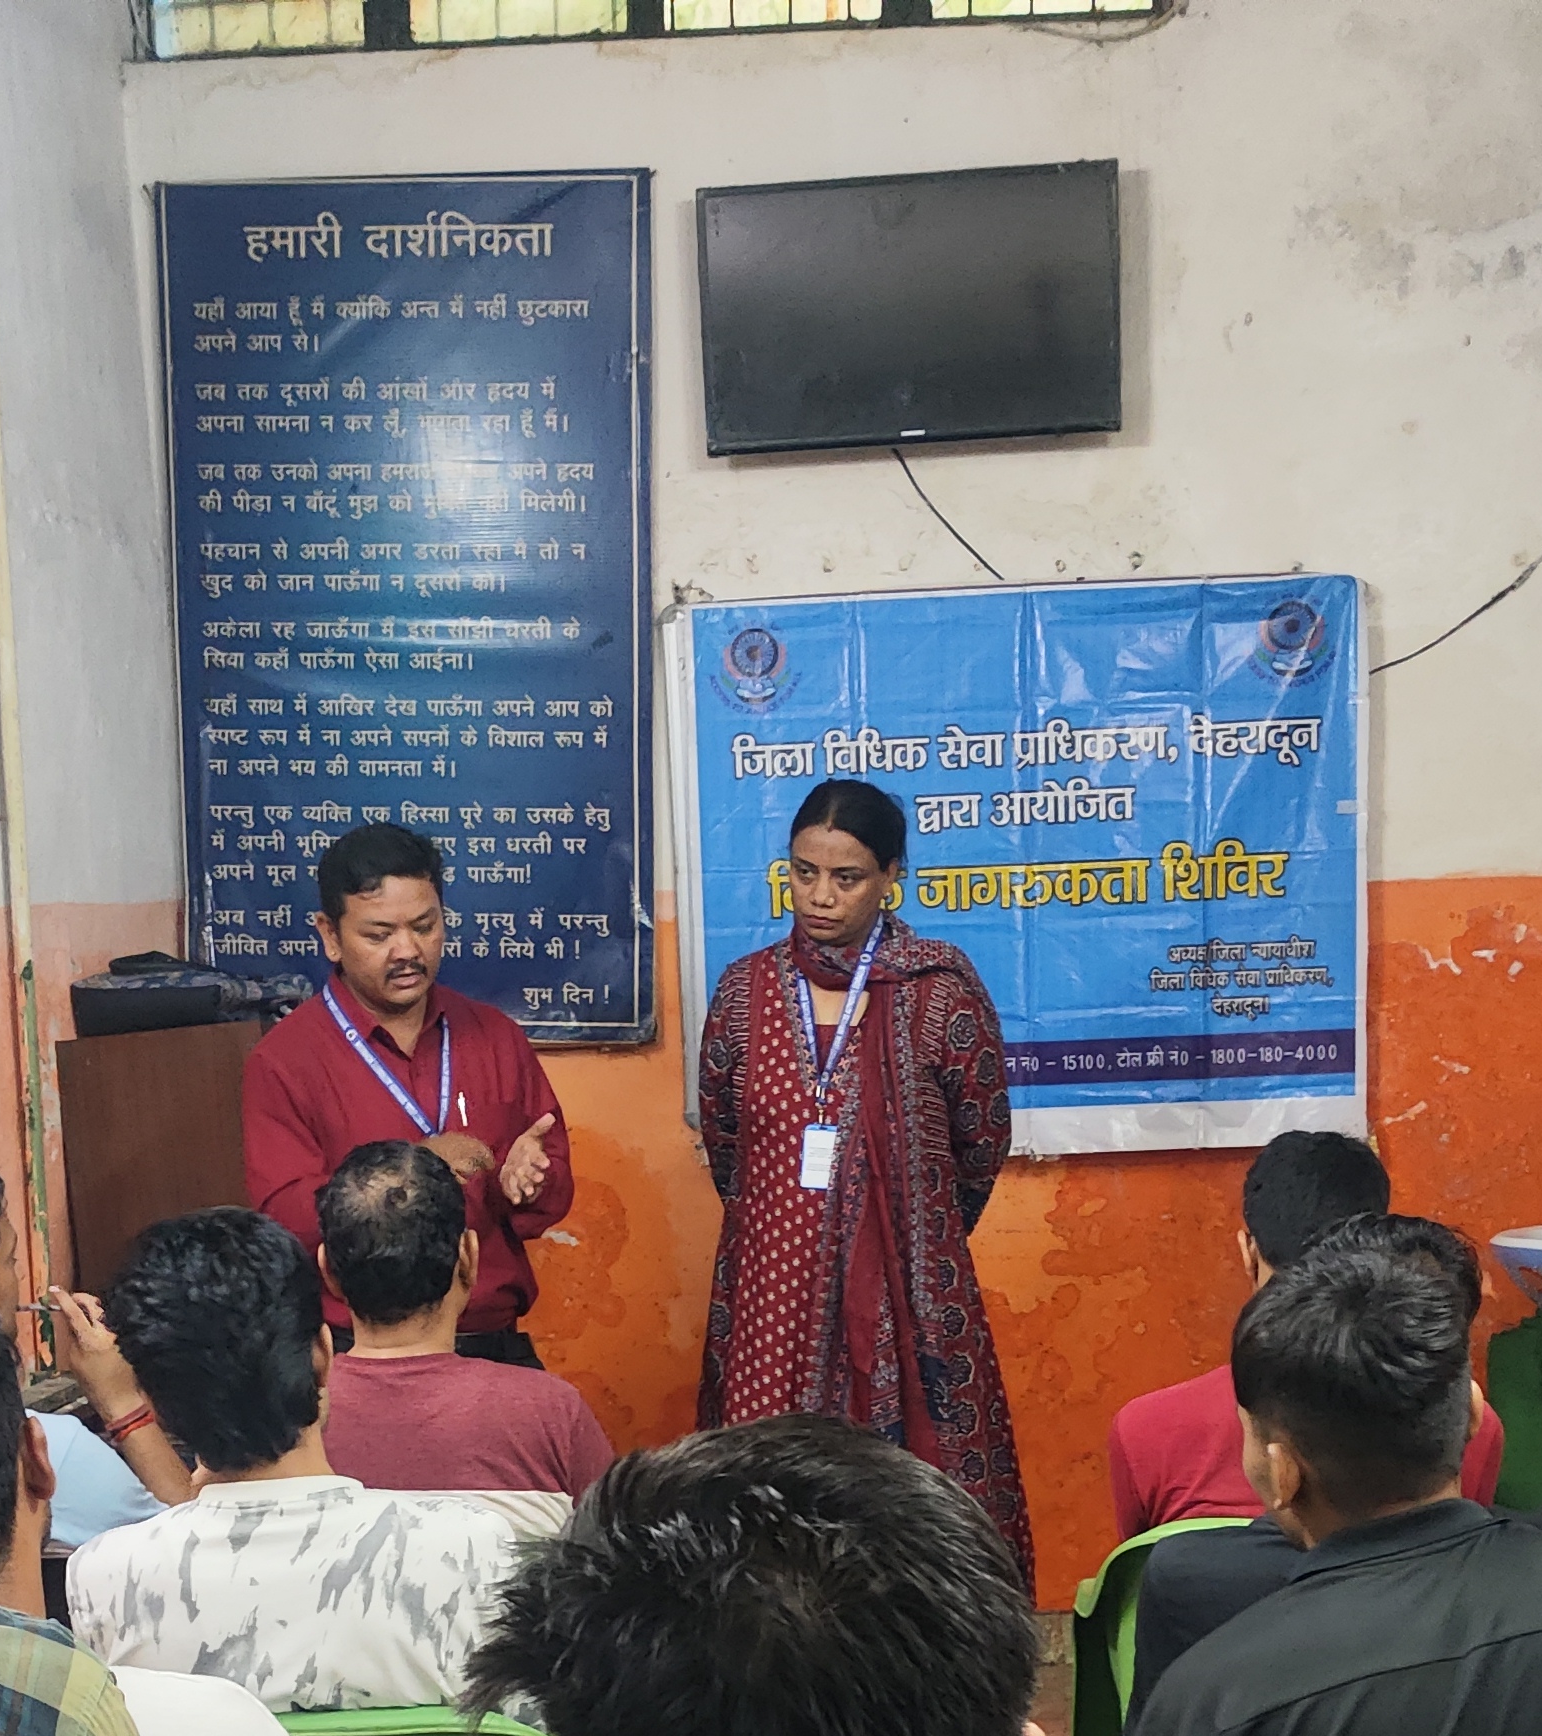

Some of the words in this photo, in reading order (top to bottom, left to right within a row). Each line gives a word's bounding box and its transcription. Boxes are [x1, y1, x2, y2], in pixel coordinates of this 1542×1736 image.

[243, 212, 343, 262] हमारी
[363, 210, 554, 259] दार्शनिकता
[194, 328, 236, 352] अपने
[247, 334, 282, 352] आप
[204, 646, 244, 669] सिवा
[254, 647, 288, 671] कहाँ
[299, 647, 355, 670] पाऊँगा
[364, 647, 399, 673] ऐसा
[409, 647, 473, 672] आईना।
[204, 692, 237, 717] यहाँ
[247, 699, 283, 715] साथ
[294, 692, 307, 716] में
[317, 693, 375, 716] आखिर
[385, 695, 416, 716] देख
[427, 695, 482, 716] पाऊँगा
[492, 694, 534, 717] अपने
[545, 700, 579, 717] आप
[589, 695, 613, 717] को
[208, 728, 249, 745] स्पष्ट
[259, 729, 287, 746] रूप
[297, 723, 311, 746] में
[321, 729, 341, 746] ना
[350, 724, 392, 747] अपने
[402, 724, 450, 747] सपनों
[460, 725, 477, 746] के
[488, 724, 544, 748] विशाल
[554, 731, 584, 748] रूप
[593, 725, 608, 748] में
[731, 734, 815, 779] जिला
[823, 728, 930, 774] विधिक
[937, 725, 1006, 769] सेवा
[1013, 717, 1179, 769] प्राधिकरण,
[1189, 714, 1321, 766] देहरादून
[209, 805, 255, 829] परन्तु
[263, 805, 293, 824] एक
[302, 800, 352, 823] व्यक्ति
[362, 806, 391, 825] एक
[401, 800, 450, 824] हिस्सा
[459, 801, 482, 829] पूरे
[493, 807, 516, 824] का
[526, 803, 574, 824] उसके
[584, 802, 611, 831] हेतु
[915, 793, 982, 834] द्वारा
[990, 778, 1136, 827] आयोजित
[916, 858, 1151, 911] जागरुकता
[1160, 839, 1289, 901] शिविर
[214, 910, 245, 925] अब
[258, 905, 291, 928] नहीं
[475, 913, 516, 935] मृत्यु
[529, 907, 544, 929] में
[558, 914, 609, 936] परन्तु
[215, 933, 268, 956] जीवित
[278, 934, 318, 956] अपने
[472, 937, 490, 957] के
[500, 937, 534, 958] लिये
[544, 937, 564, 958] भी
[1149, 967, 1185, 990] जिला
[1190, 966, 1229, 990] विधिक
[1234, 963, 1260, 986] सेवा
[523, 987, 553, 1009] शुभ
[562, 982, 594, 1004] दिन
[1116, 1047, 1142, 1067] टोल
[1146, 1045, 1164, 1066] फ्री
